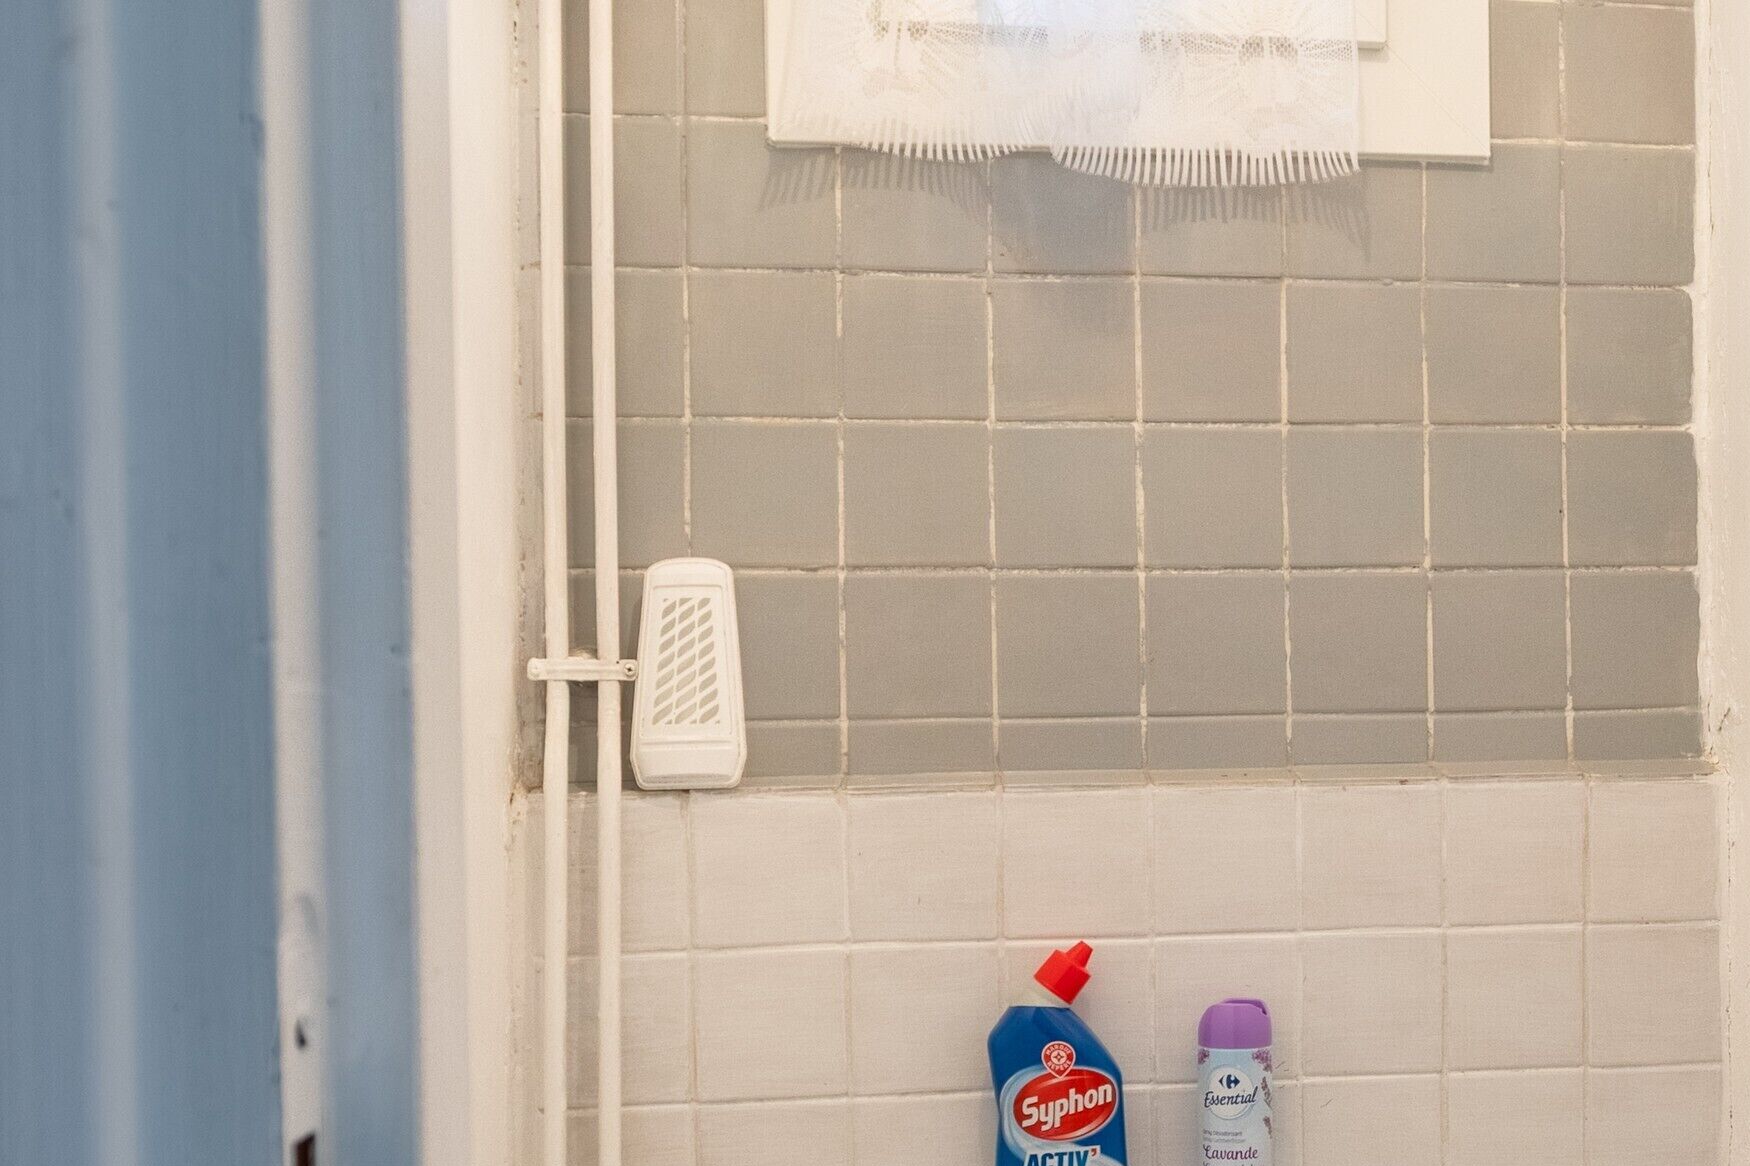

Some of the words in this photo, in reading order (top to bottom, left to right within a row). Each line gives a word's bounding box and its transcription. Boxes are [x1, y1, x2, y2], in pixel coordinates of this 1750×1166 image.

[1021, 1083, 1112, 1132] Syphon
[1204, 1086, 1258, 1108] Essential
[1202, 1144, 1258, 1160] Lavande
